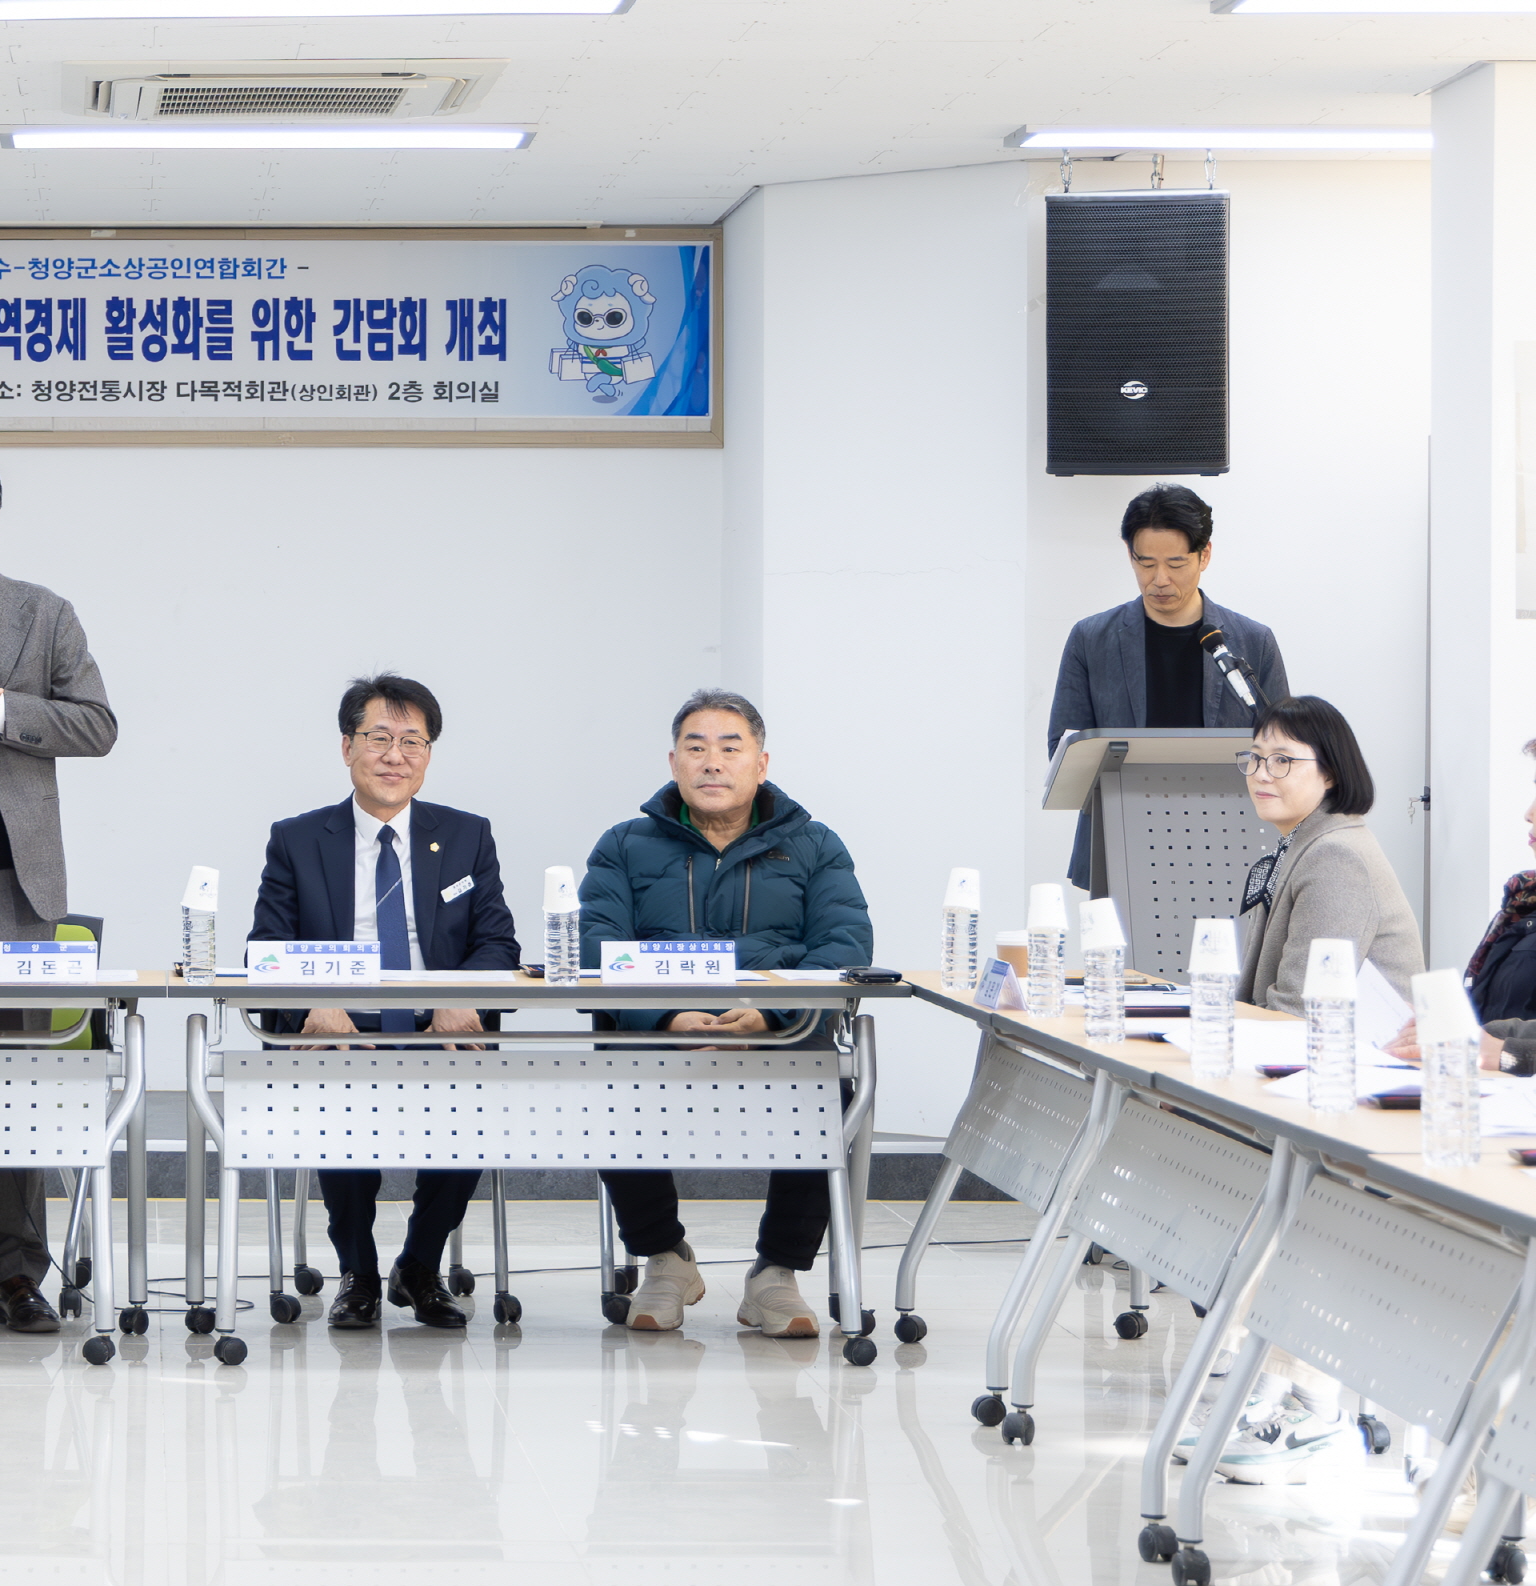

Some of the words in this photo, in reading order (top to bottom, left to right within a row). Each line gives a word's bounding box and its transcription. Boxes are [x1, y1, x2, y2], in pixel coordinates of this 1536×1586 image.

[104, 296, 234, 363] 활성화를
[250, 296, 317, 362] 위한
[332, 296, 427, 362] 간담회
[444, 296, 507, 362] 개최
[31, 379, 168, 402] 청양전통시장
[387, 380, 424, 402] 2층
[432, 380, 499, 403] 회의실
[300, 960, 366, 976] 김기준
[655, 960, 720, 975] 김락원
